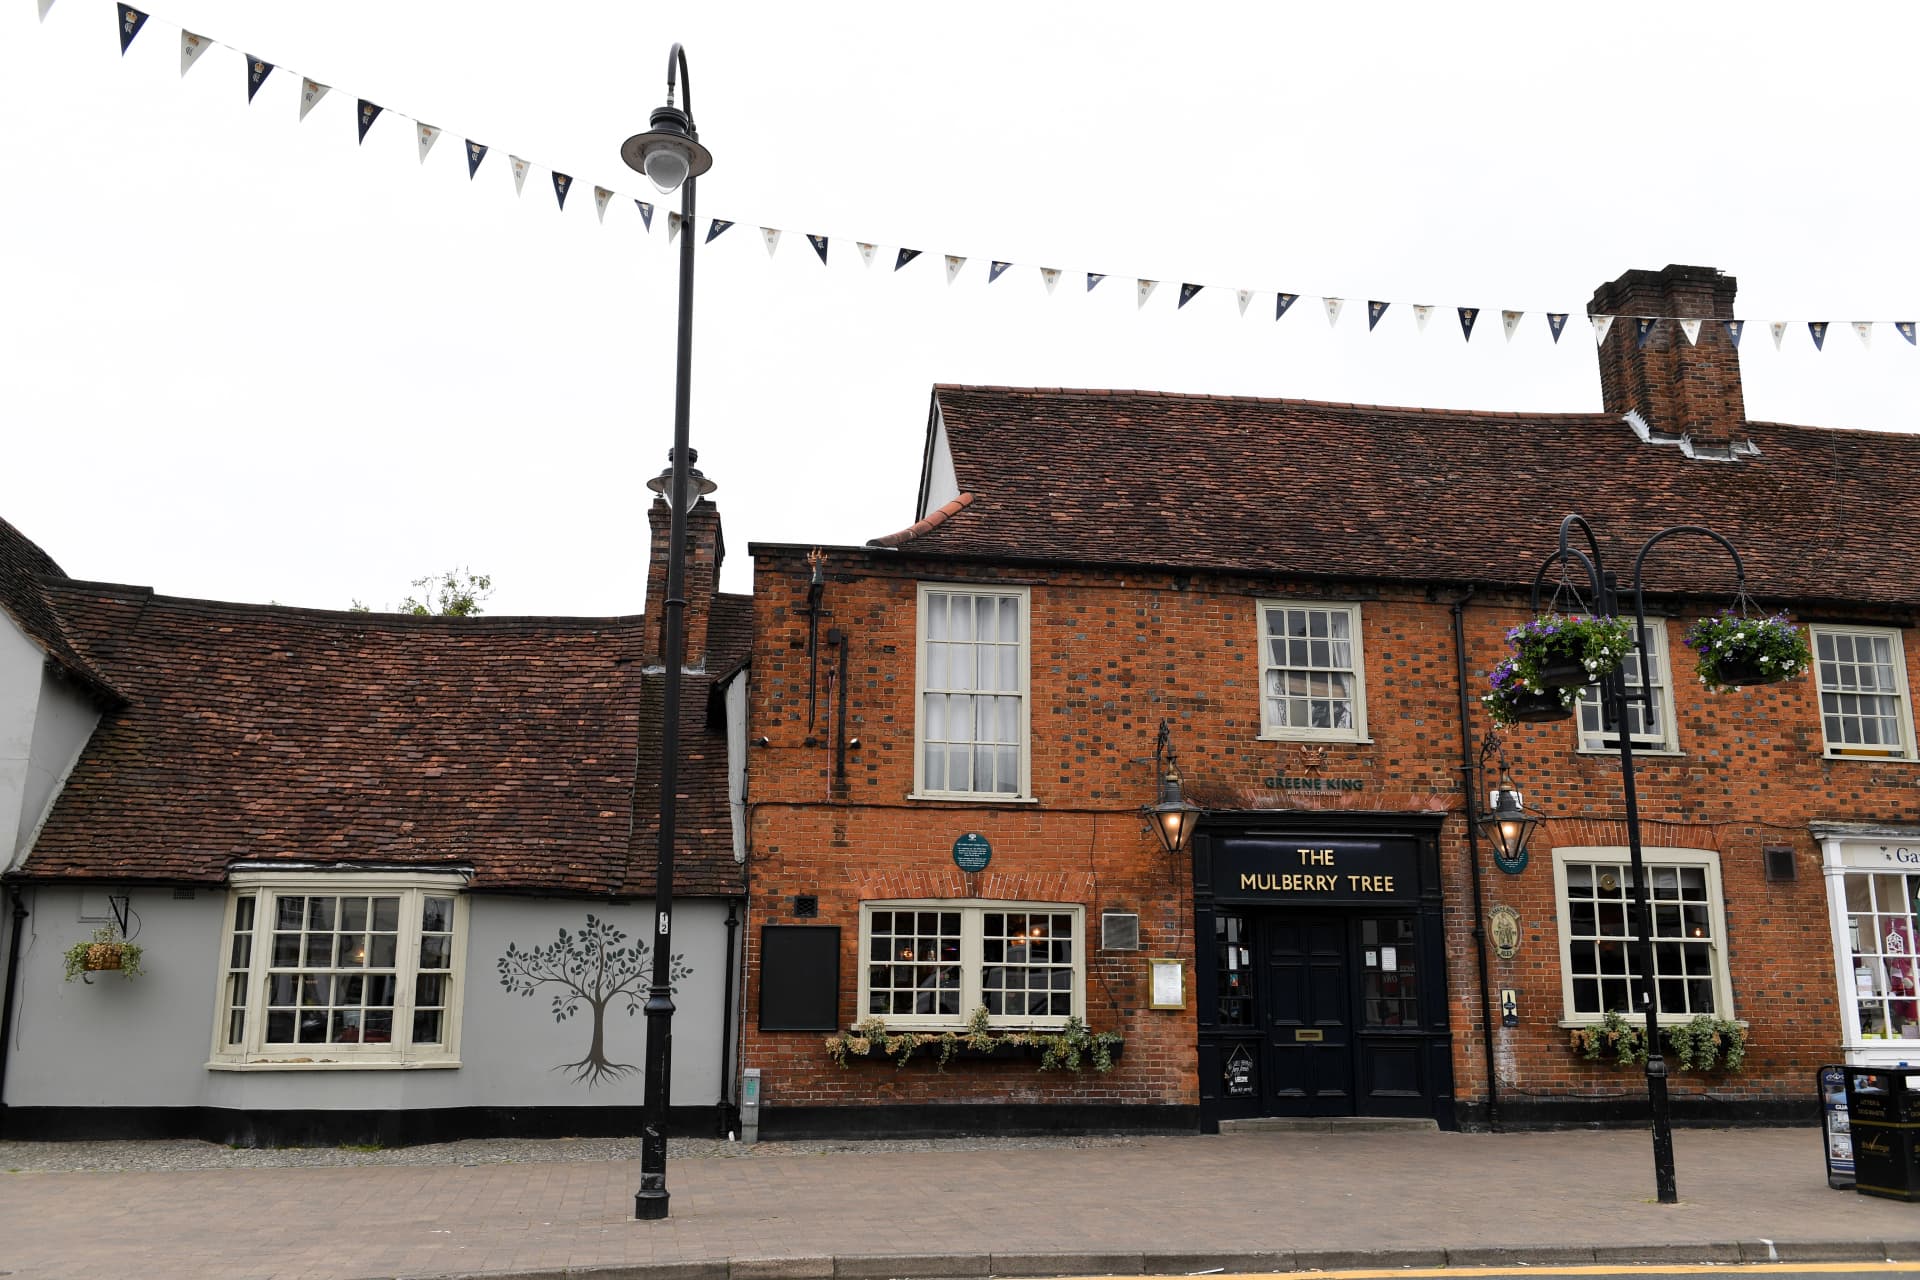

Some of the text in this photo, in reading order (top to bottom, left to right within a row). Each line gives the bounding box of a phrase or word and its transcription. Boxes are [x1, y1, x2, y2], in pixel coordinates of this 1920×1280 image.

[1265, 777, 1364, 791] GREENE KING
[1297, 849, 1335, 866] THE
[1240, 873, 1395, 892] MULBERRY TREE
